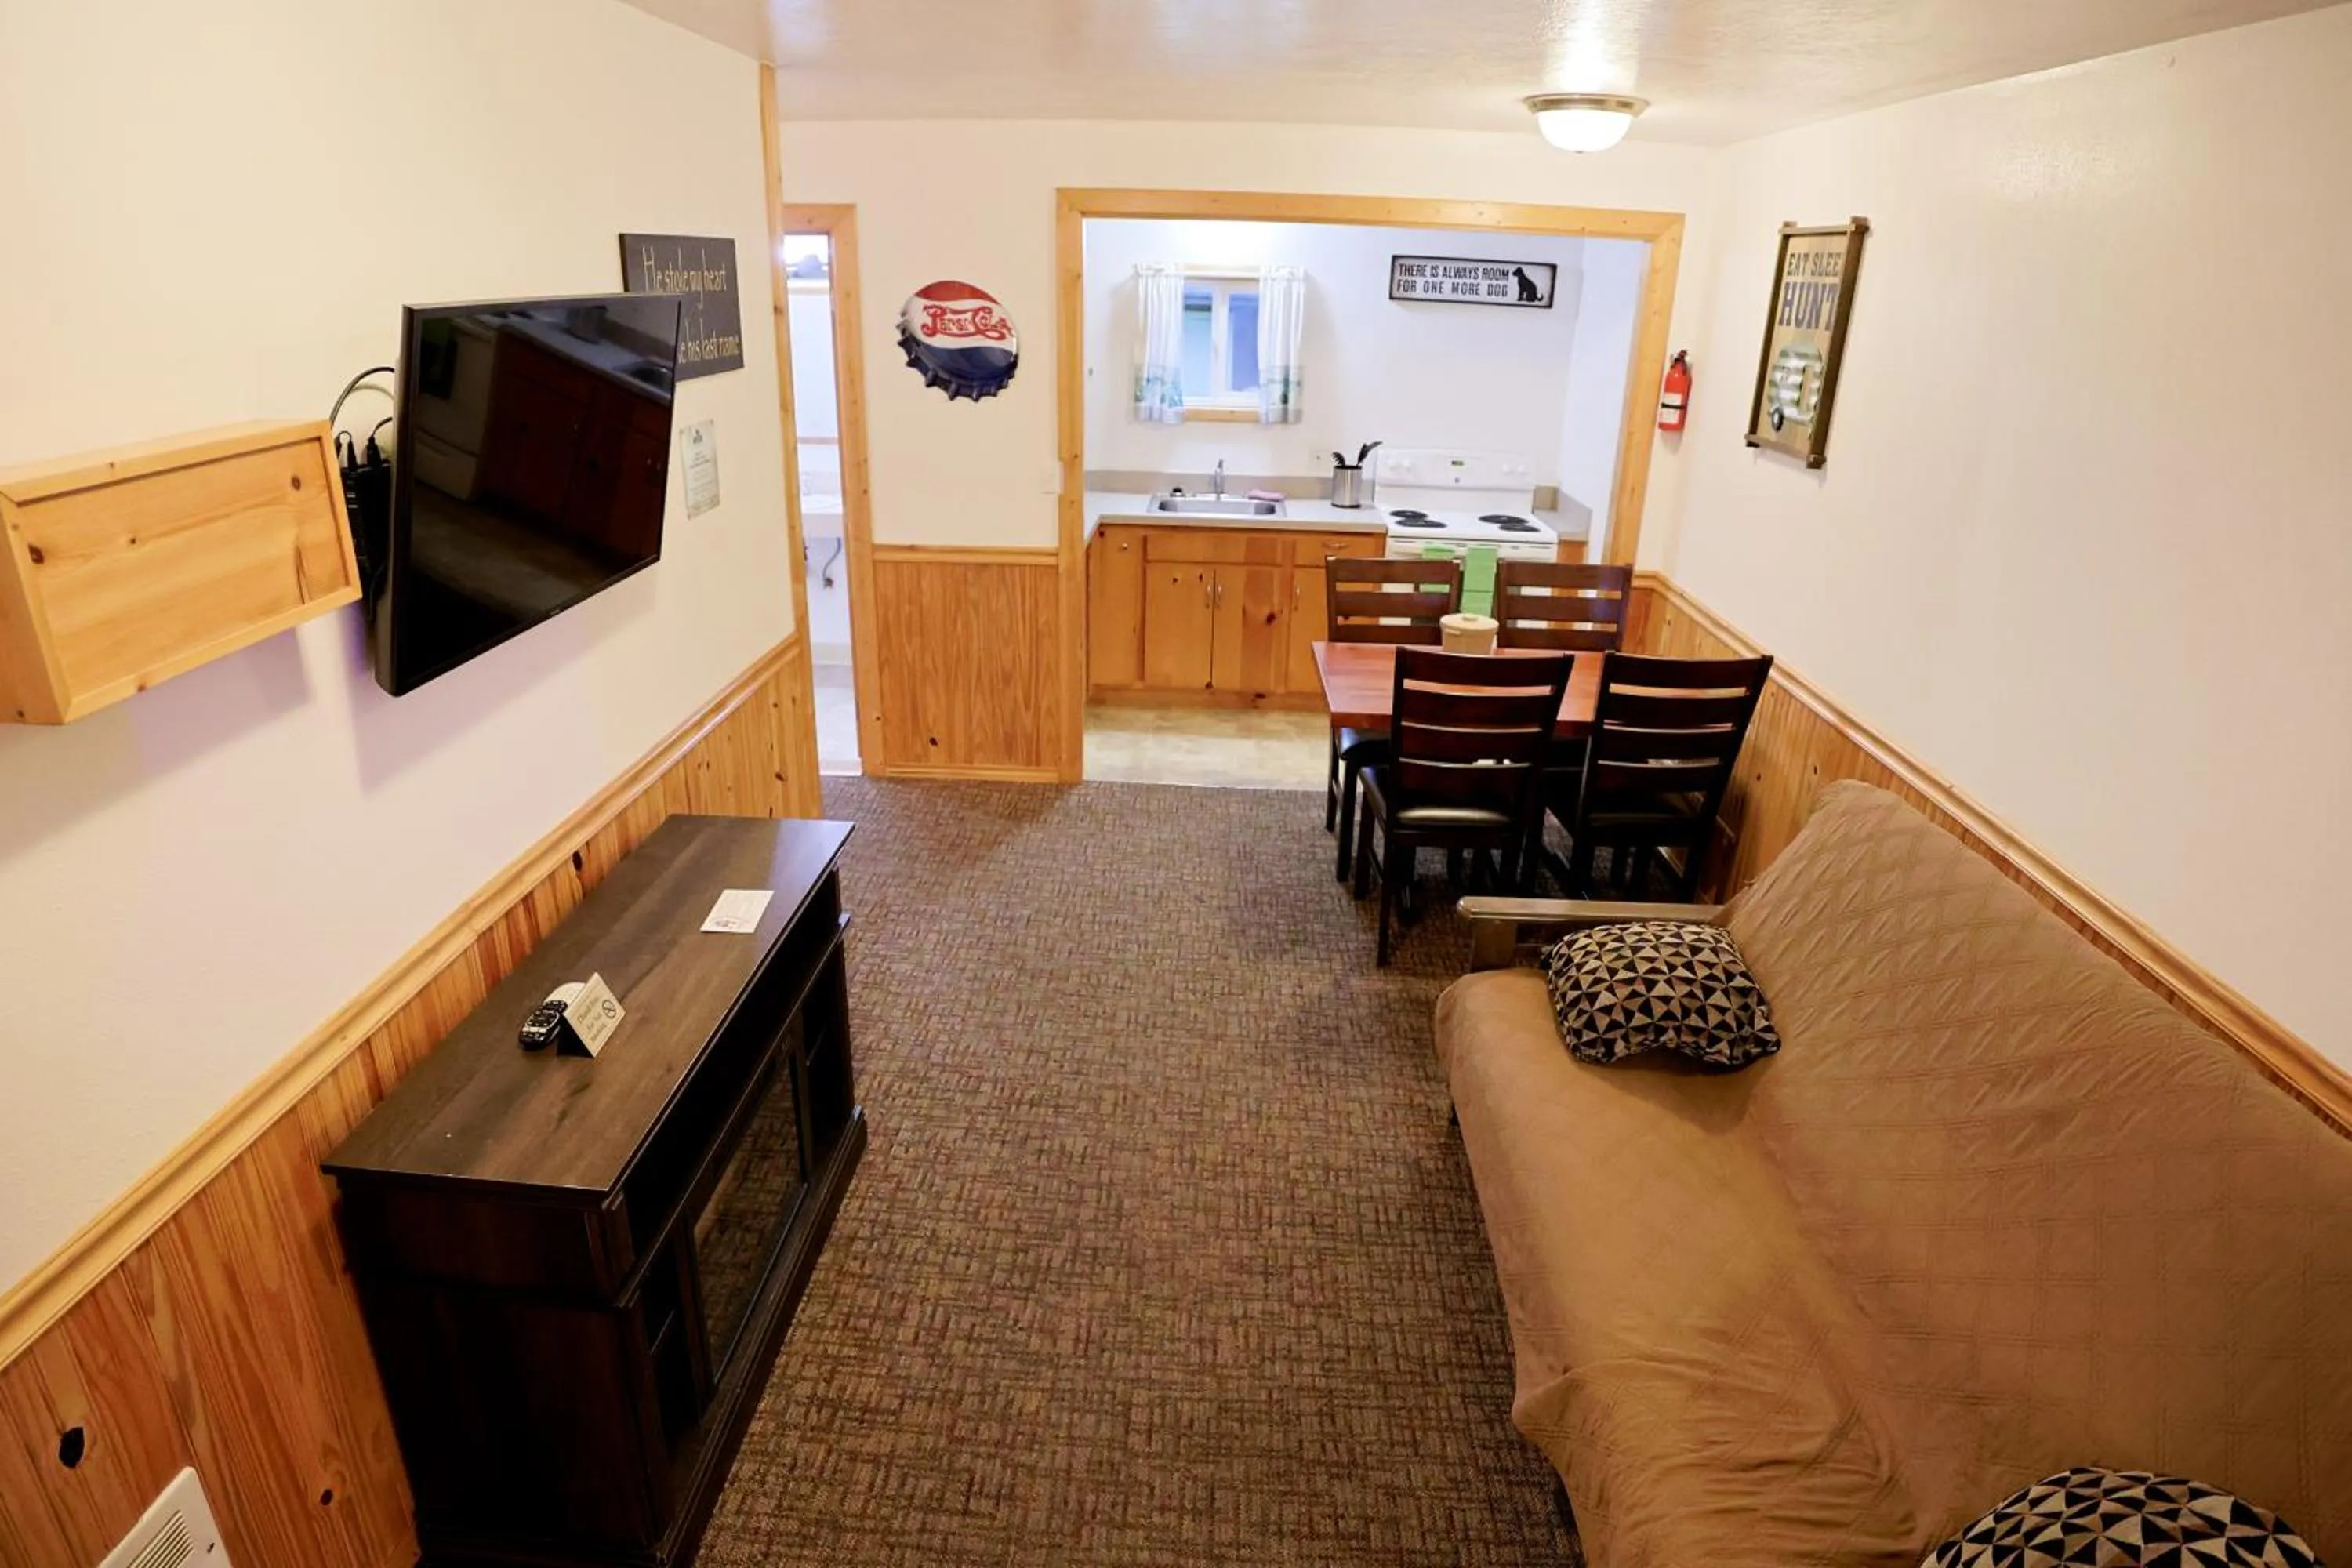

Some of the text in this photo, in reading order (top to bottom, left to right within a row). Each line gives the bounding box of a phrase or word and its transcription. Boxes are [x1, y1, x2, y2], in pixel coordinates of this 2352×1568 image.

[643, 245, 662, 292] He
[664, 247, 688, 292] stole
[1398, 263, 1509, 281] THERE IS ALWAYS ROOM
[1787, 252, 1844, 276] EAT SLEE
[1396, 279, 1508, 297] FOR ONE MORE DOG
[1779, 281, 1840, 331] HUNT
